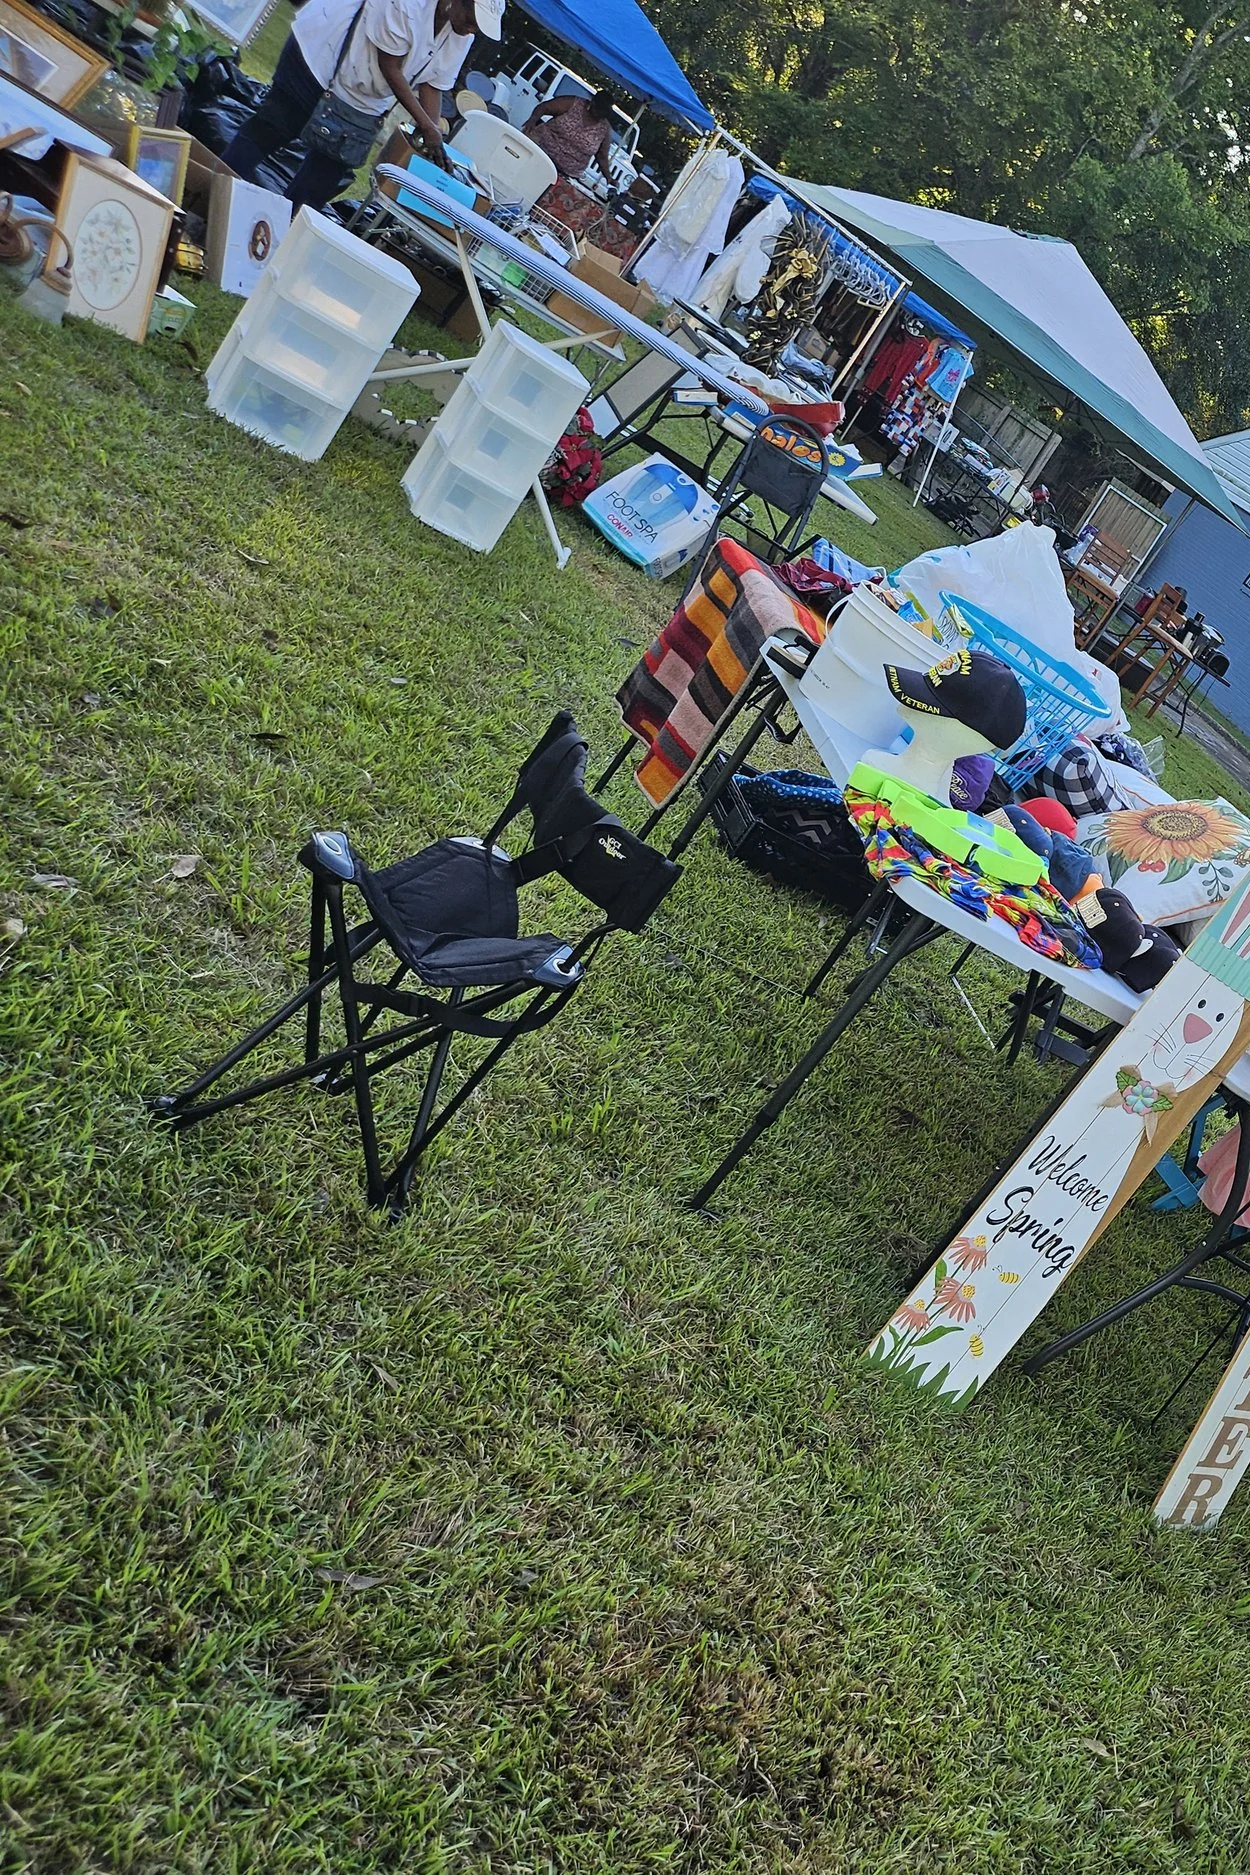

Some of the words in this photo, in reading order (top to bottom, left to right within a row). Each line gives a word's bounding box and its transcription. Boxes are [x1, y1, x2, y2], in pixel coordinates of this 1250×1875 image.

[605, 491, 640, 521] FOOT
[634, 518, 659, 543] SPA
[607, 513, 633, 538] CONAIR
[900, 692, 940, 715] VETERAN
[609, 837, 622, 850] GCI
[1028, 1135, 1109, 1213] Welcome
[985, 1186, 1075, 1279] Spring
